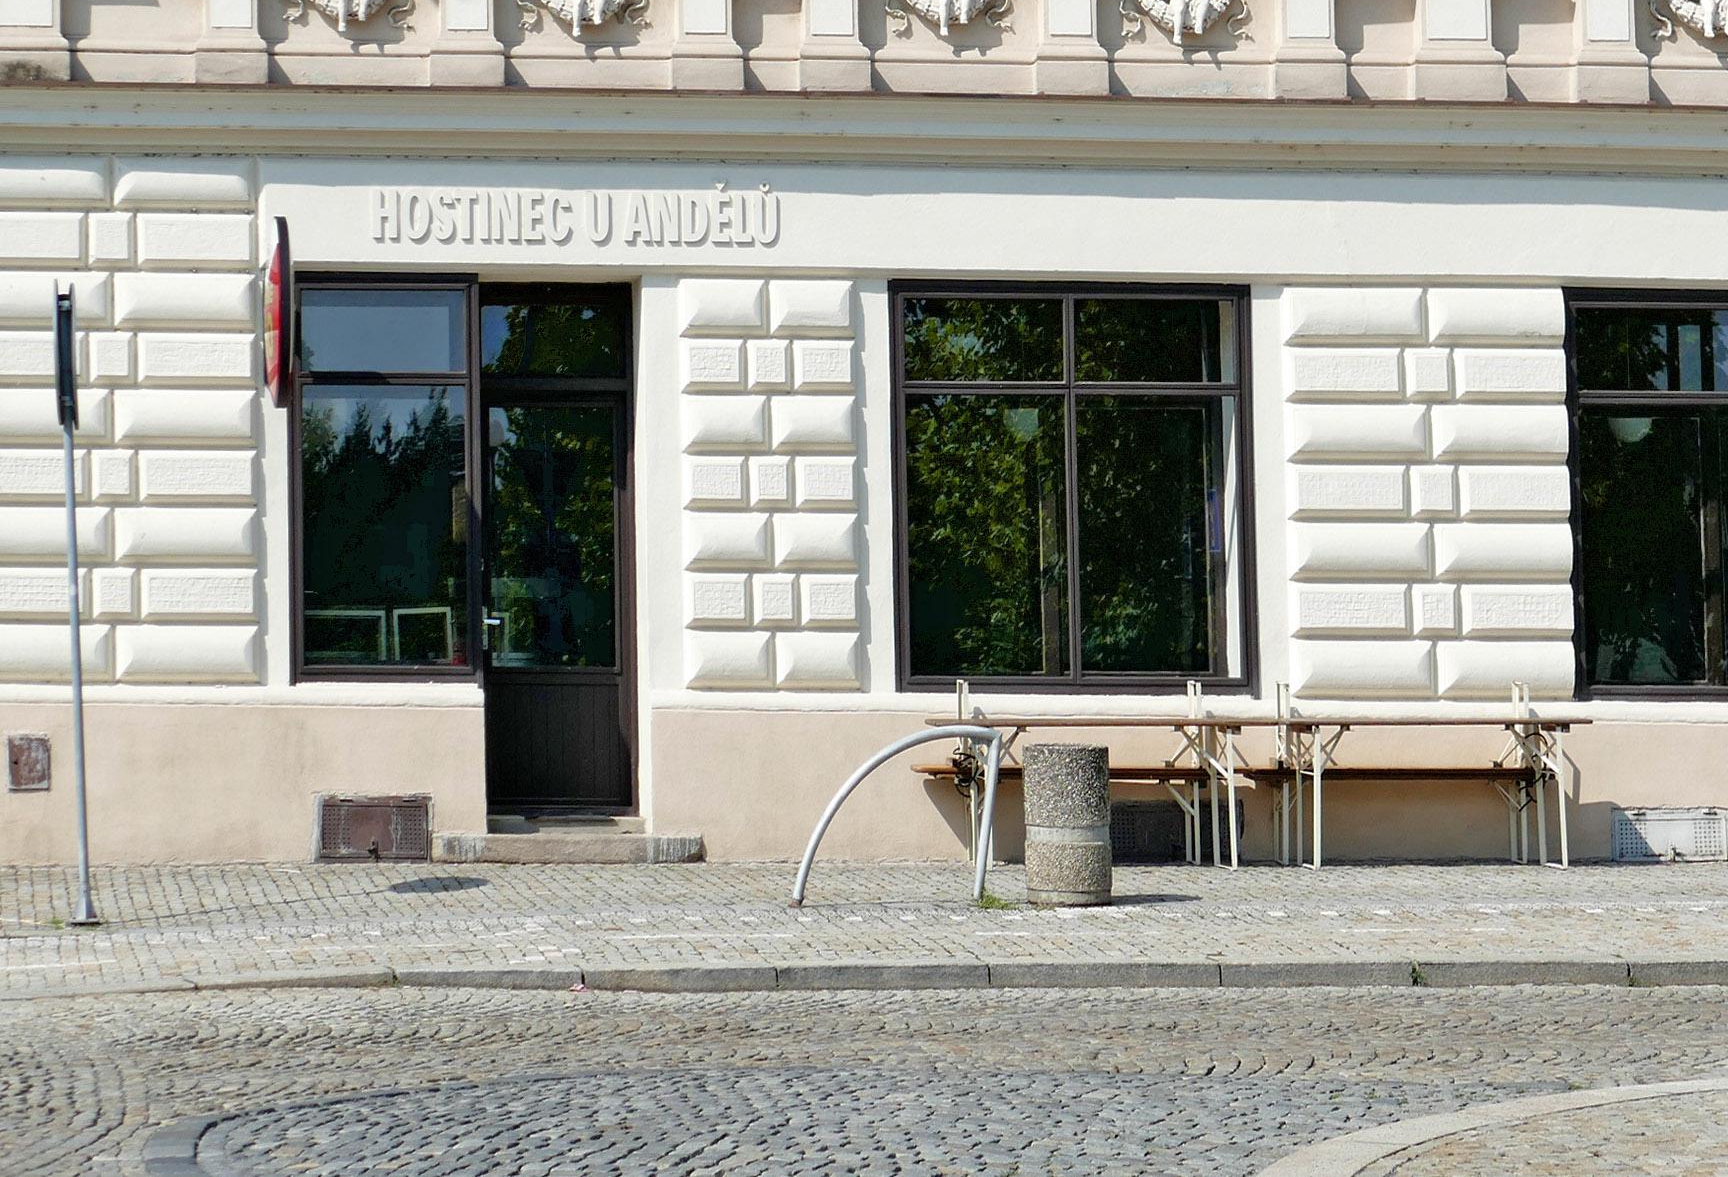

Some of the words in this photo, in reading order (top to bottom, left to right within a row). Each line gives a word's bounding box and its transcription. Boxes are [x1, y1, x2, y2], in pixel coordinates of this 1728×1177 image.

[371, 188, 574, 243] HOSTINEC
[585, 191, 614, 245] U
[624, 181, 781, 247] ANDĚLŮ
